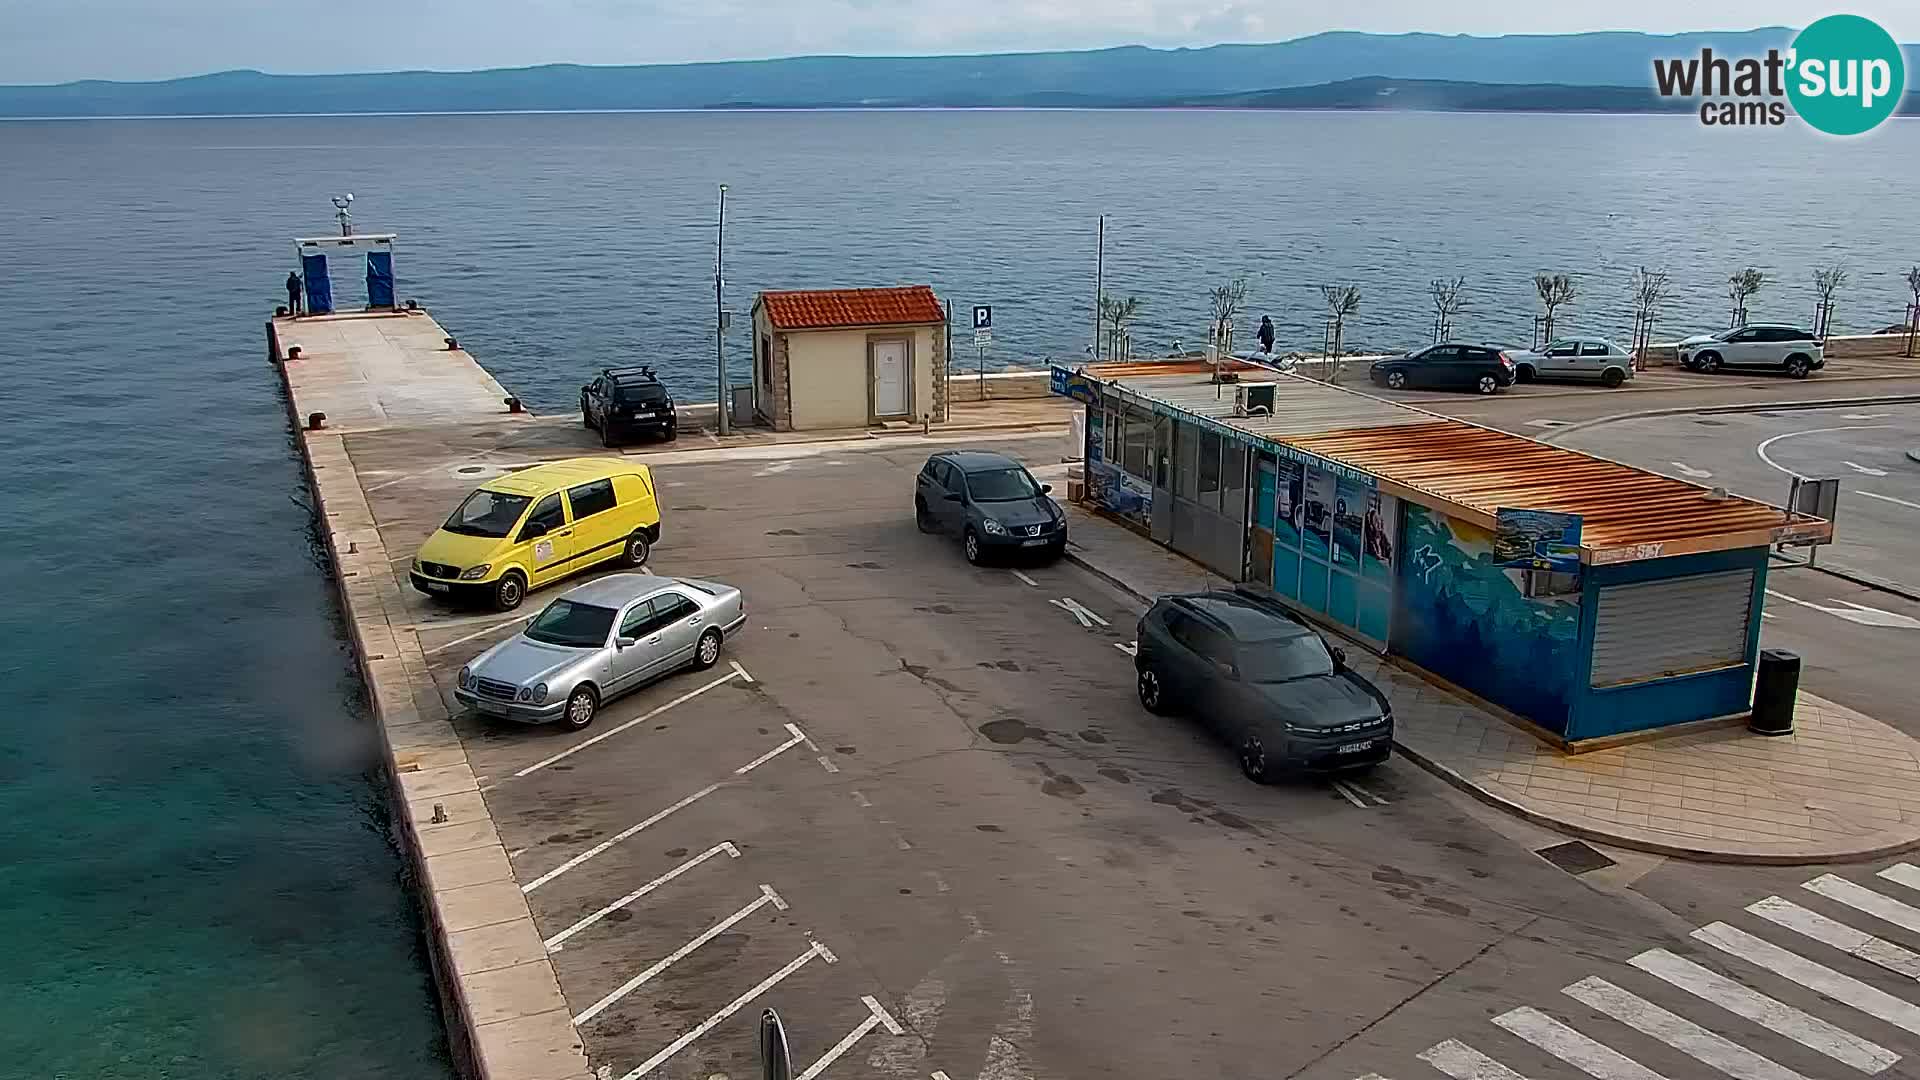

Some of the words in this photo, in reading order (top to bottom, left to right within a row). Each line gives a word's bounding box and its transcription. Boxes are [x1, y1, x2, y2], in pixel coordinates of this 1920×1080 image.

[977, 308, 988, 325] P
[1289, 449, 1319, 467] STATION
[1322, 460, 1346, 477] TICKET
[1347, 467, 1373, 485] OFFICE
